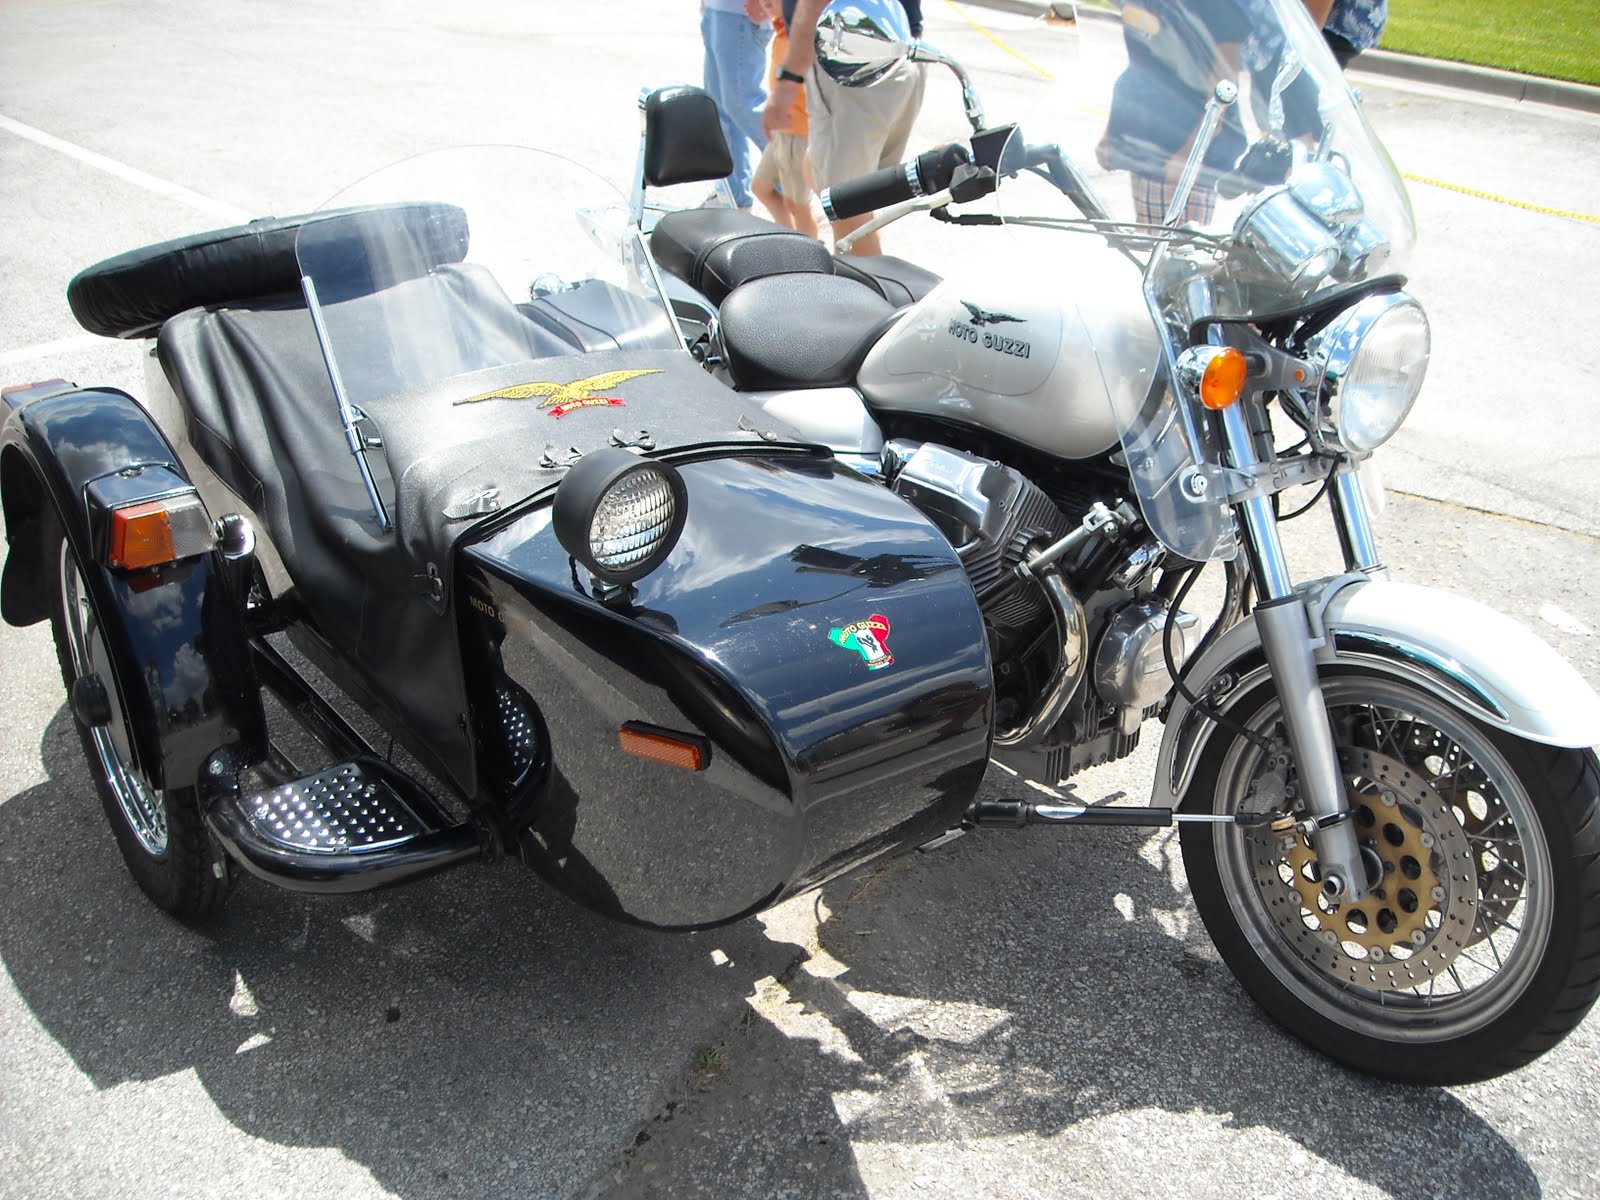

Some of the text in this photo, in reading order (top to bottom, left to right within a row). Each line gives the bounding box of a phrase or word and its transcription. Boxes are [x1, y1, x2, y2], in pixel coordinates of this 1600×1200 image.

[948, 318, 1031, 358] MOTO GUZZI
[469, 595, 495, 617] MOTO
[839, 624, 857, 645] MOTO
